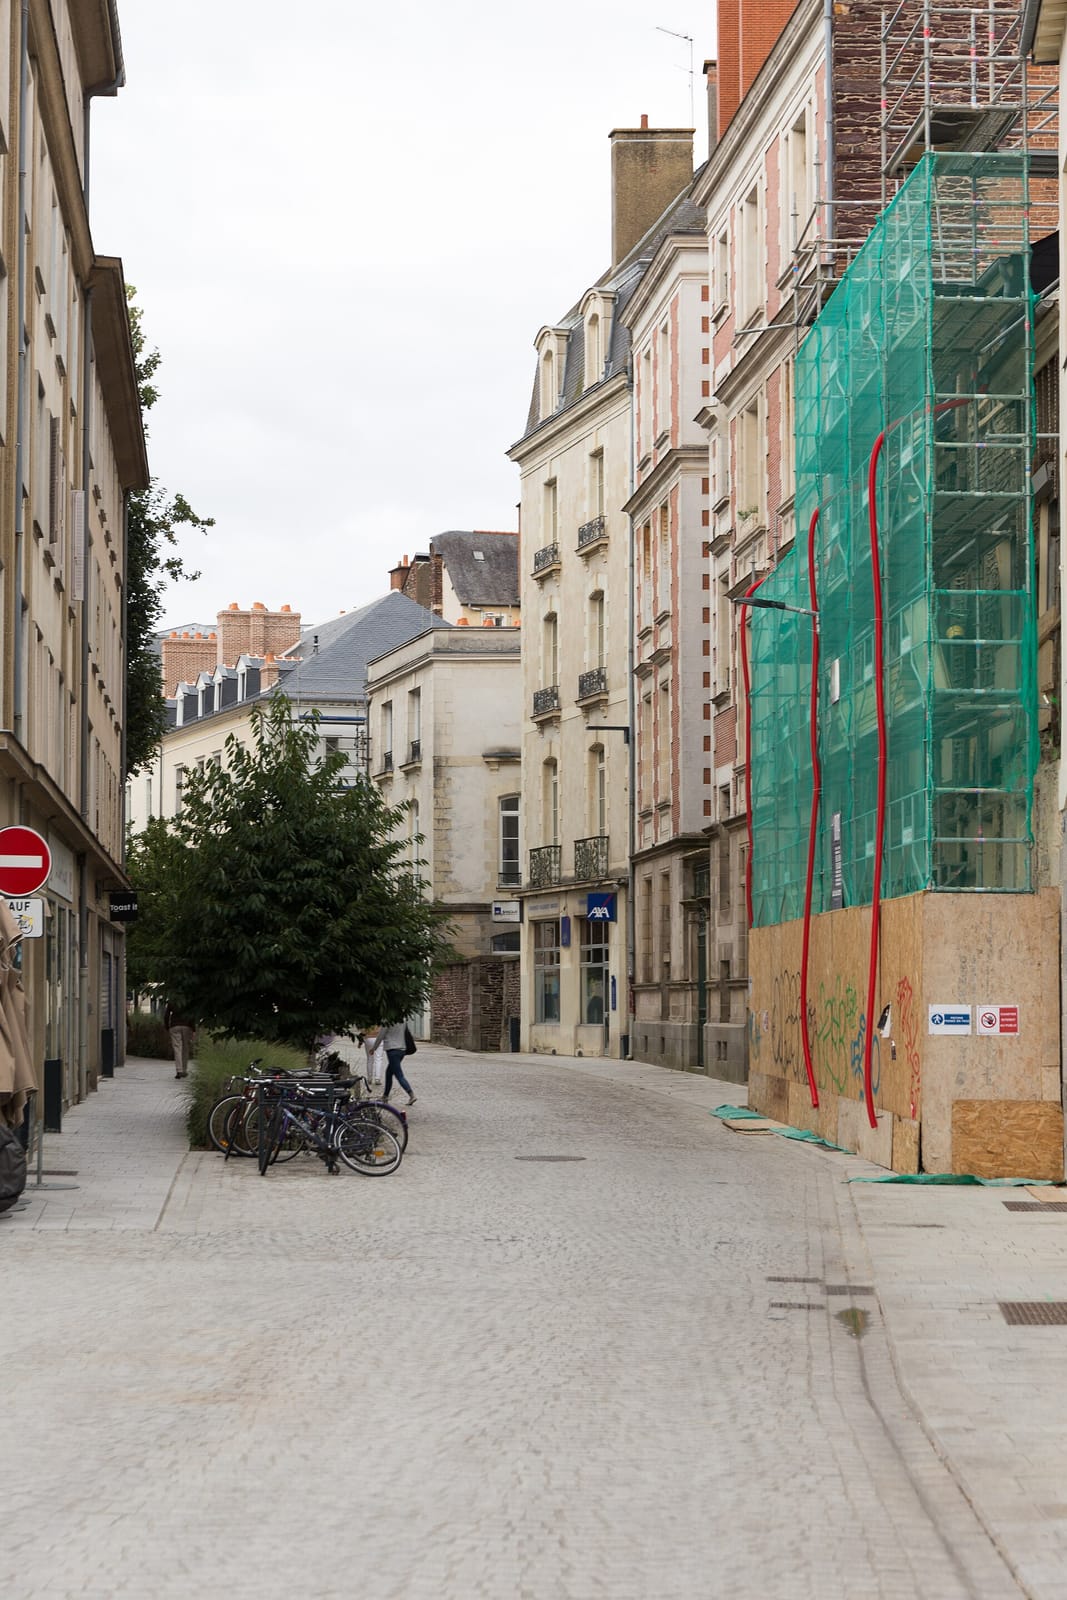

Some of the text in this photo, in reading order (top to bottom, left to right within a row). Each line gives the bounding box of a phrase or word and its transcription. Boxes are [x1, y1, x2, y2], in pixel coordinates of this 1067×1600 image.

[9, 901, 31, 911] AUF
[110, 903, 130, 912] Toast
[587, 906, 610, 918] AXA
